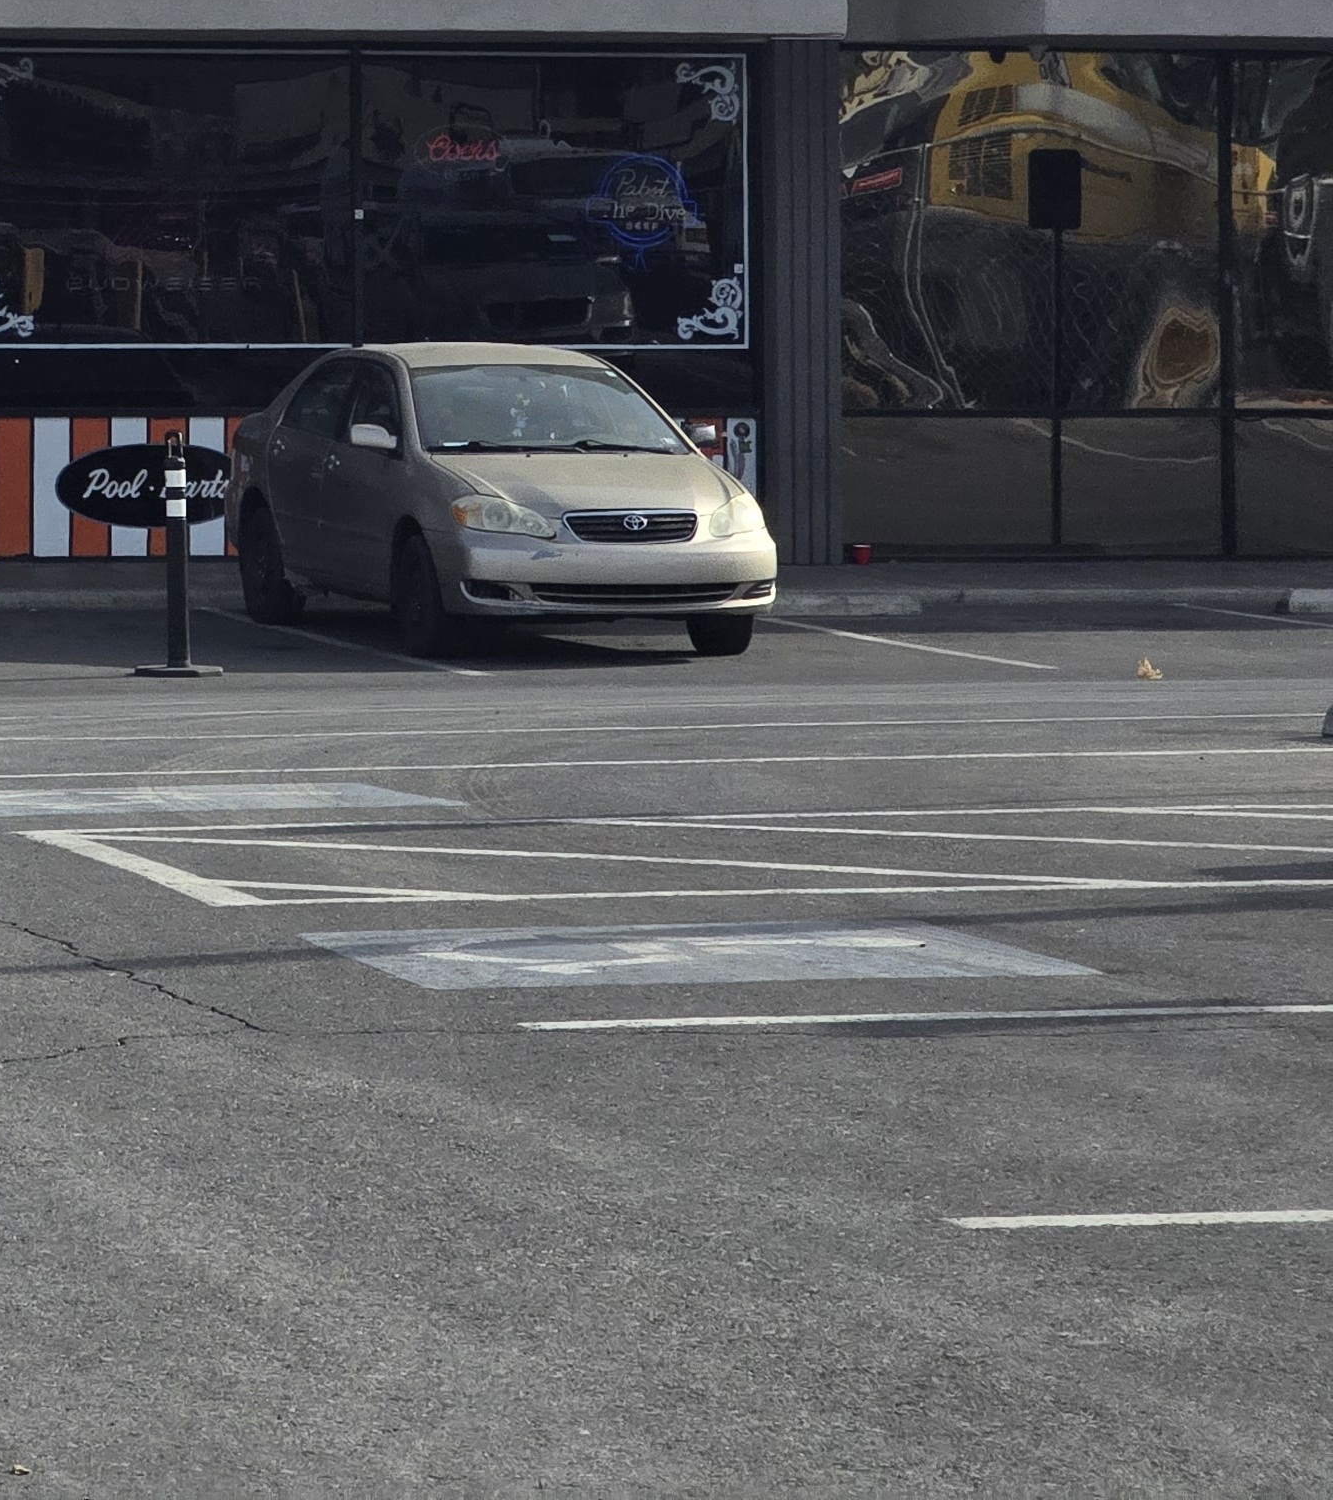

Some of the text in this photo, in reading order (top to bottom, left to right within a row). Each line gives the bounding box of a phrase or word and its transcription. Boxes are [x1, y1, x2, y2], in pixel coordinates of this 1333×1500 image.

[426, 132, 501, 161] Coors
[614, 168, 671, 197] Pabst
[83, 468, 231, 499] Pool arts
